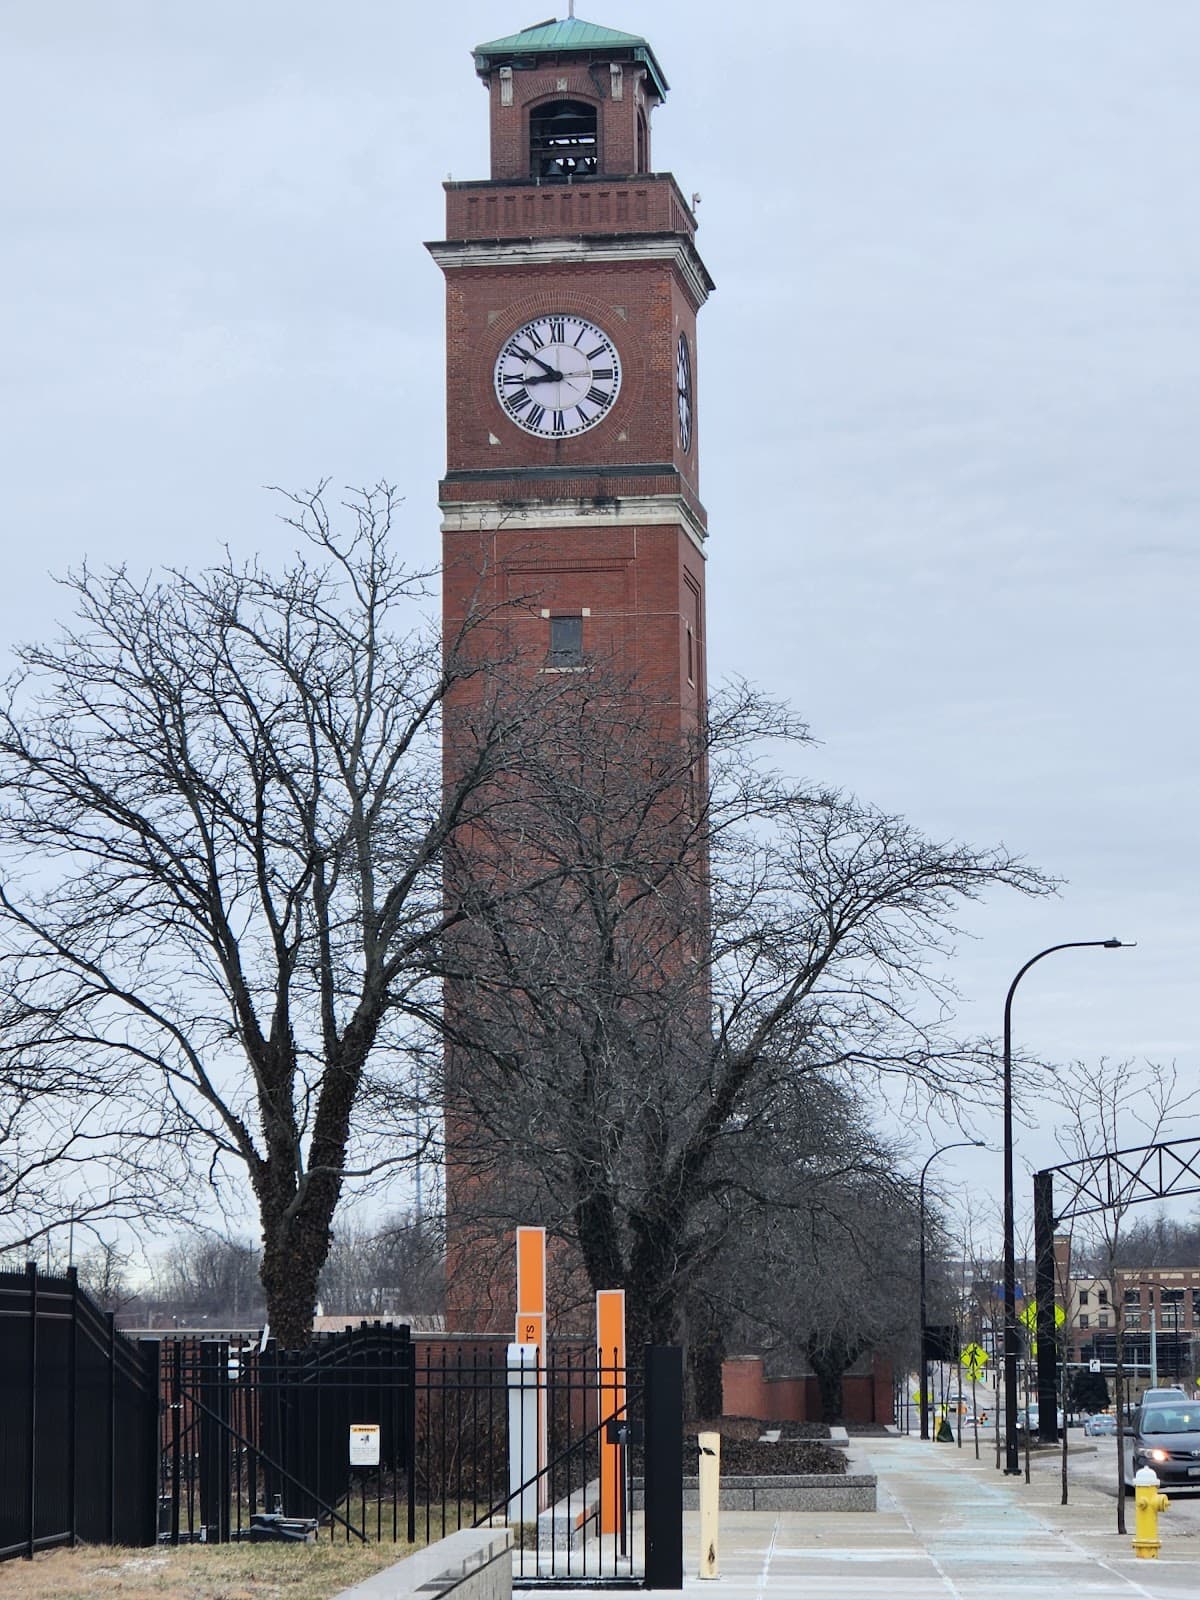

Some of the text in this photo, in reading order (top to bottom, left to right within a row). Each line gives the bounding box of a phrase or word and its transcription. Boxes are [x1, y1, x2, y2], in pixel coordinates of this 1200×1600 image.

[525, 329, 545, 350] XI
[550, 322, 564, 343] XII
[574, 328, 585, 347] I
[586, 345, 607, 360] II
[503, 373, 524, 386] IX
[592, 369, 613, 380] III
[506, 388, 532, 413] VIII
[585, 386, 609, 407] IIII
[526, 404, 546, 427] VII
[553, 410, 565, 431] VI
[575, 404, 589, 423] V
